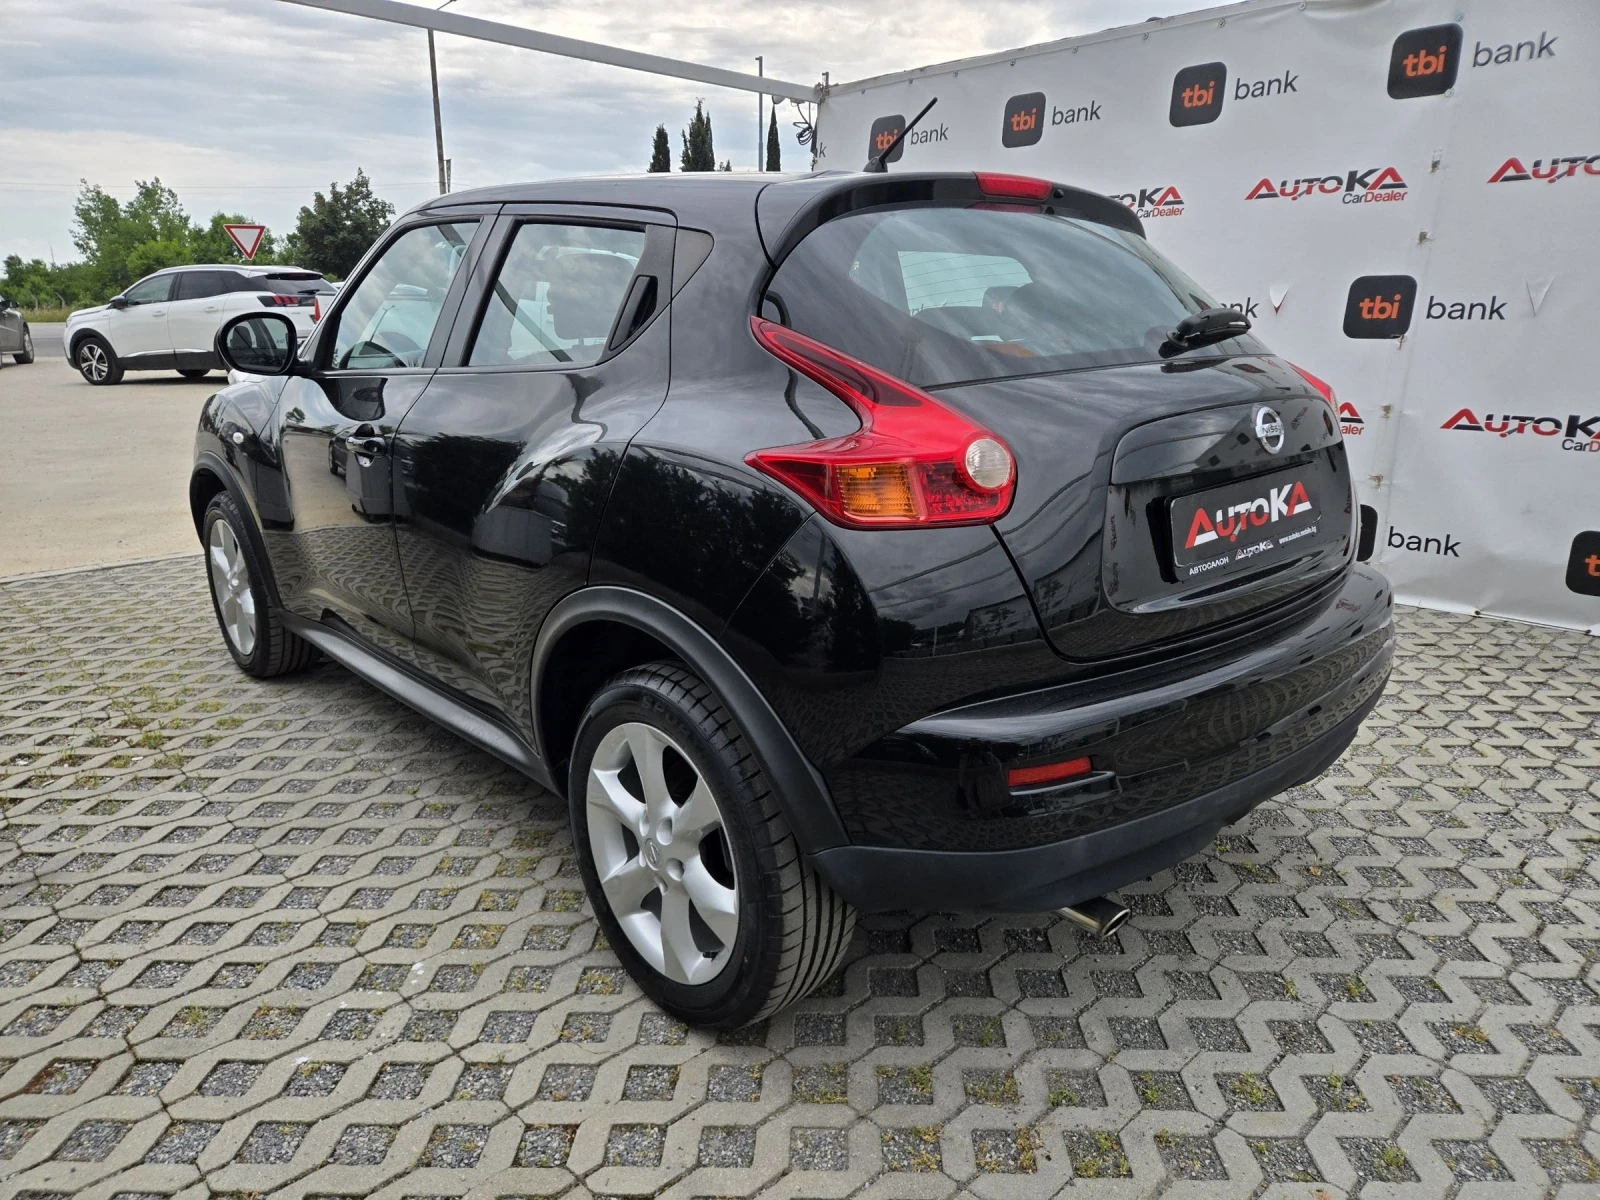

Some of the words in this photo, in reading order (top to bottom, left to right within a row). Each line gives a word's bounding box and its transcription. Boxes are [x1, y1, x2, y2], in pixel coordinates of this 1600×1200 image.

[1403, 45, 1447, 77] tbi
[1472, 31, 1558, 68] bank
[1182, 81, 1215, 108] tbi
[1234, 70, 1299, 100] bank
[1011, 108, 1036, 131] tbi
[1051, 100, 1102, 126] bank
[910, 123, 949, 146] bank
[1245, 166, 1408, 201] AUTOKA
[1359, 294, 1401, 320] tbi
[1426, 296, 1508, 321] bank
[1185, 481, 1313, 549] AUTOKA
[1387, 525, 1462, 558] bank
[1189, 556, 1229, 576] АВТОСАЛОН
